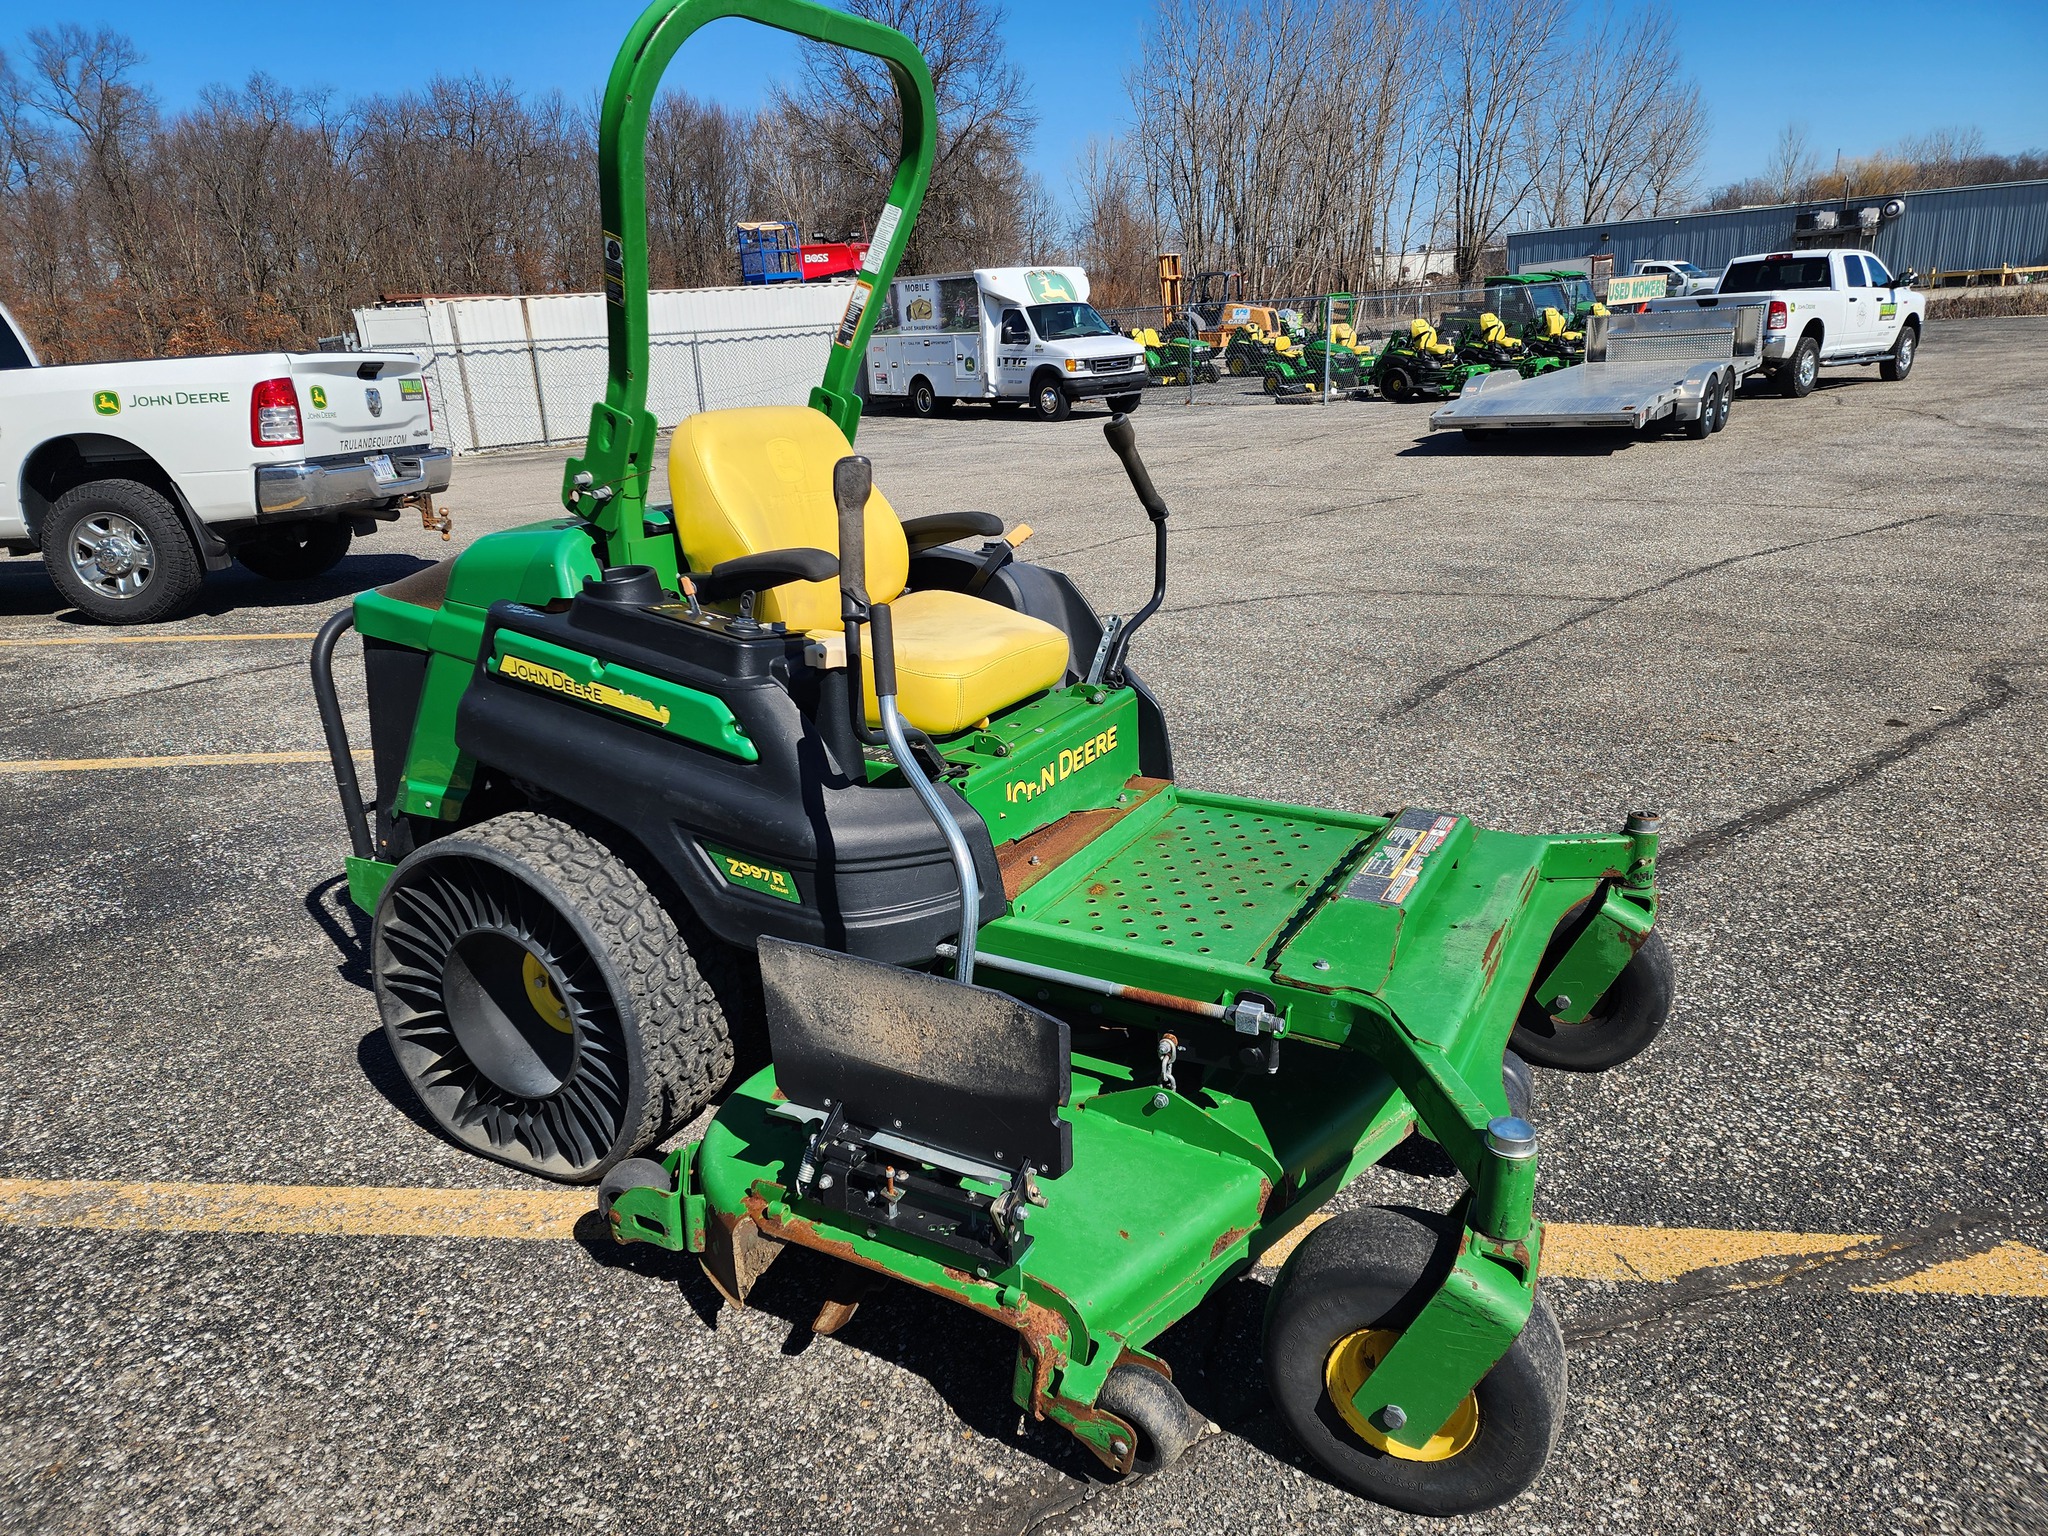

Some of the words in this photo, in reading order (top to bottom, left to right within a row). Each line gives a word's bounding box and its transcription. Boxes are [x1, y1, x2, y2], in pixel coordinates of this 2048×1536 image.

[804, 253, 829, 263] BOSS
[904, 283, 930, 293] MOBILE
[1608, 282, 1630, 301] USED
[1632, 279, 1666, 298] MOWERS
[1003, 357, 1027, 367] TTG
[129, 394, 173, 408] JOHN
[175, 392, 231, 405] DEERE
[307, 412, 321, 420] JOHN
[340, 434, 407, 451] TRULANDEQUIP.COM
[510, 660, 550, 687] JOHN
[552, 672, 603, 702] DEERE
[1058, 724, 1118, 782] DEERE
[770, 884, 789, 895] Diesel
